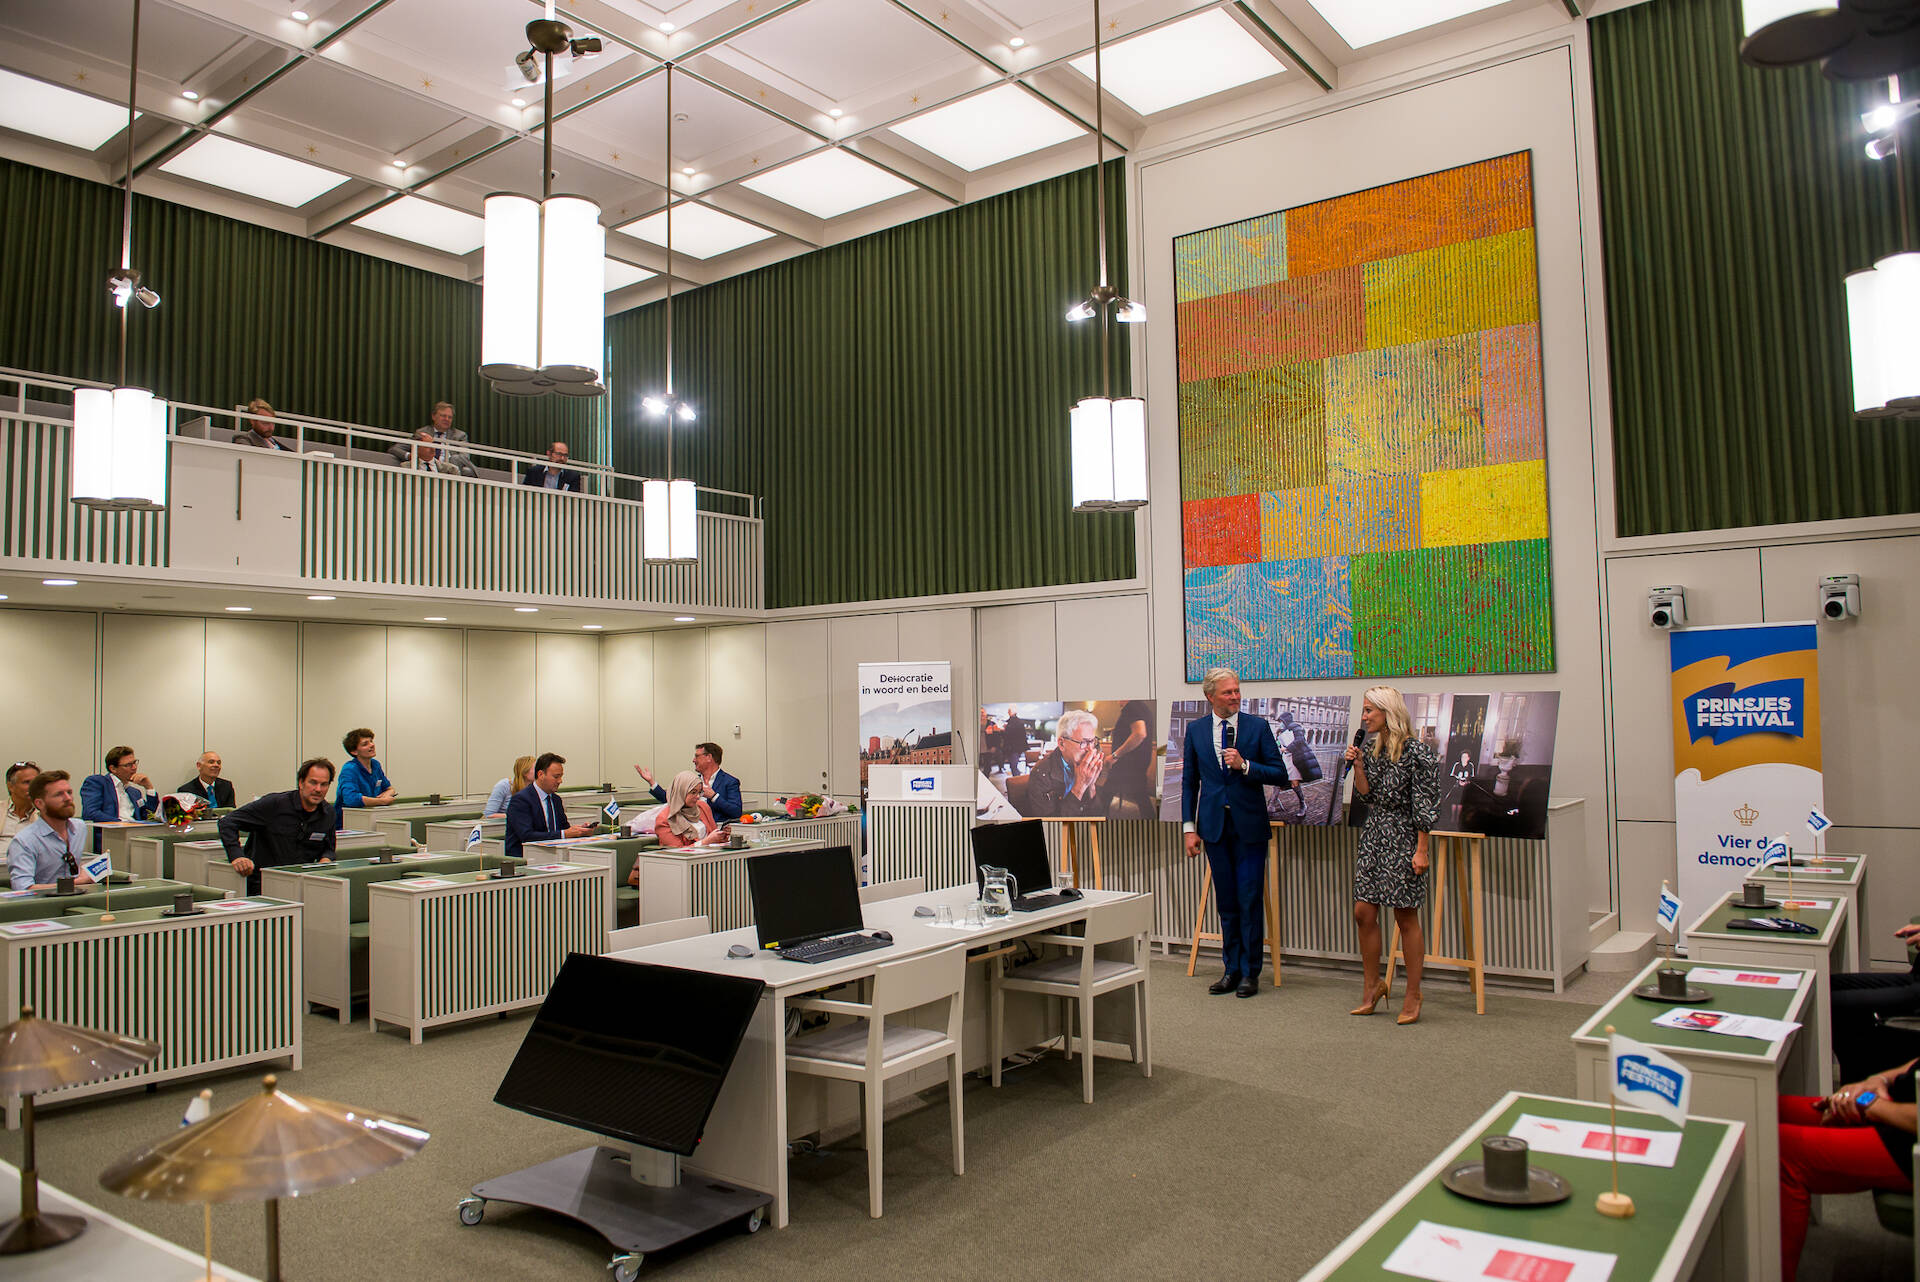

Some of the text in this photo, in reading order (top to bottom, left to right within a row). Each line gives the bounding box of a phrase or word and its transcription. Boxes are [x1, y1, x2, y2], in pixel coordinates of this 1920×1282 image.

[862, 686, 871, 694] in
[873, 686, 904, 694] woord
[921, 684, 949, 693] beeld
[1697, 697, 1792, 712] PRINSJES
[1697, 712, 1794, 726] FESTIVAL
[1717, 834, 1772, 850] Vier d
